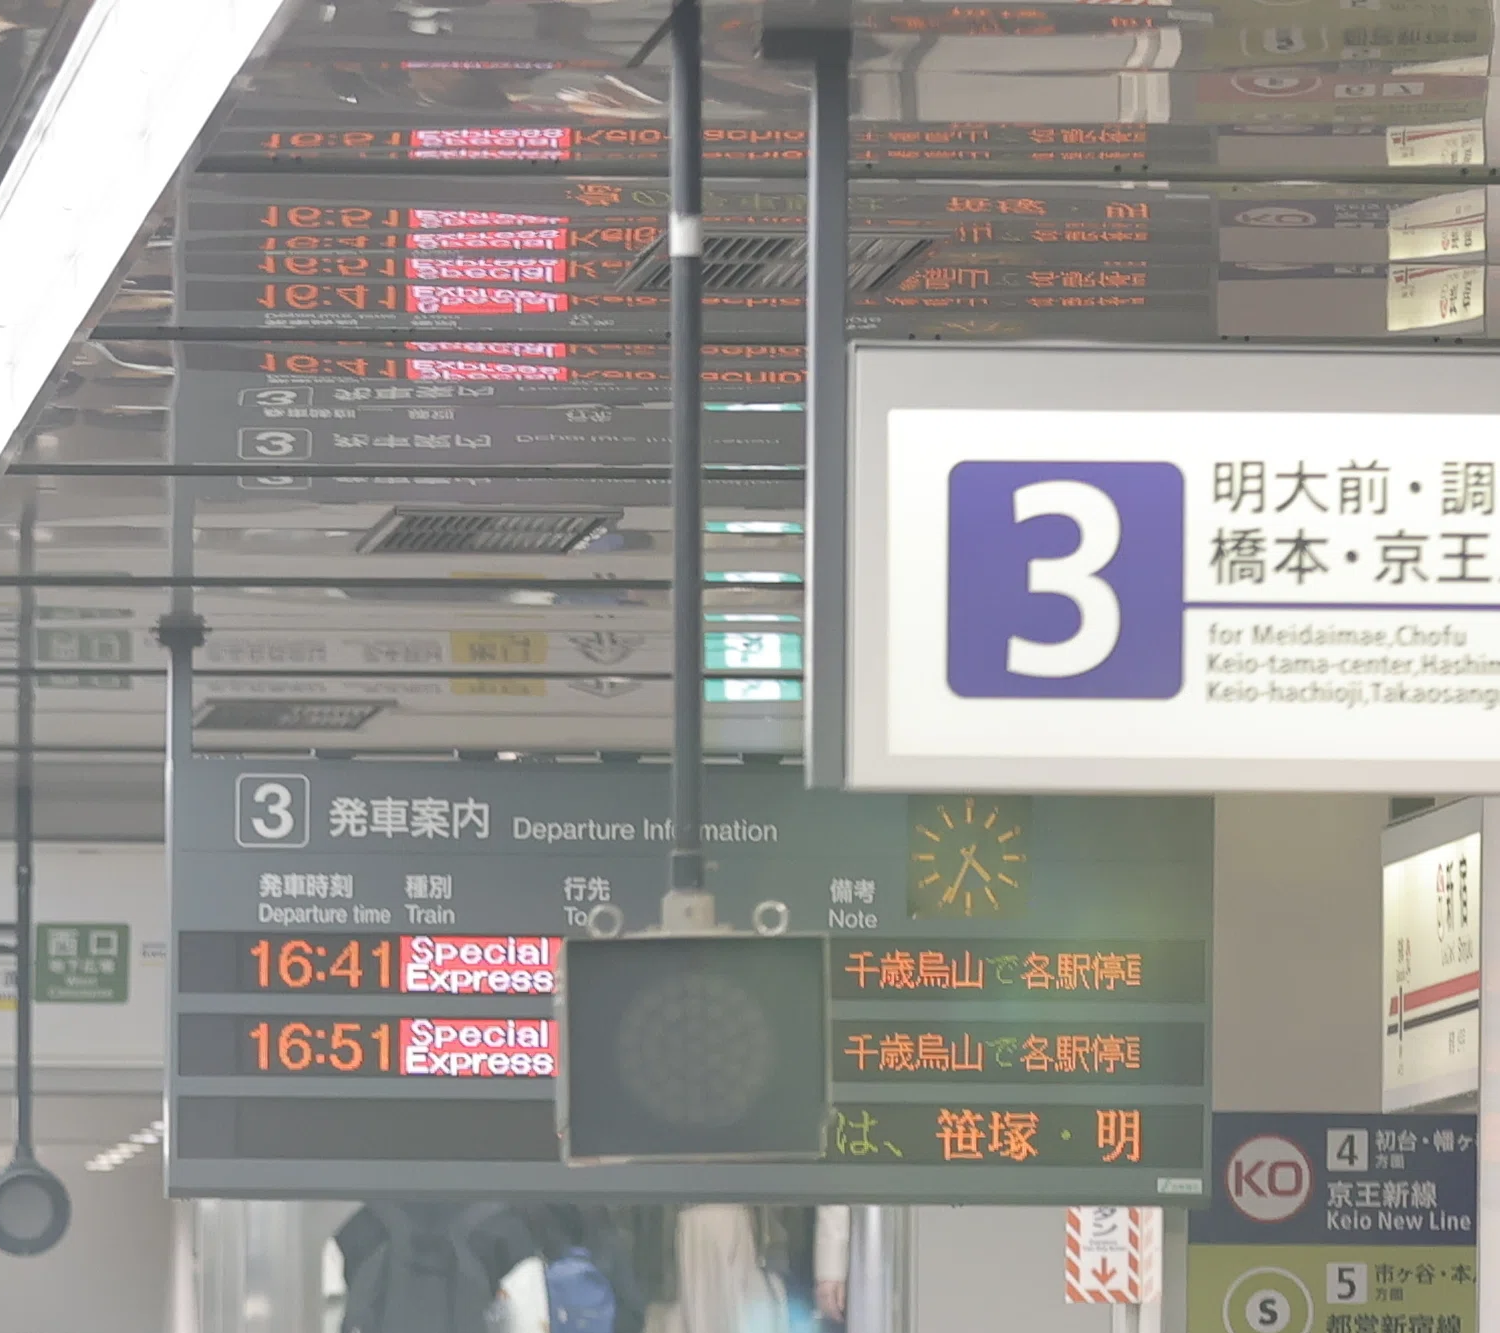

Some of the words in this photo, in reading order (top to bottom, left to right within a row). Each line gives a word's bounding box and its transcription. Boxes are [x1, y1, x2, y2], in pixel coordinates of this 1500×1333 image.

[1006, 479, 1122, 679] 3
[1208, 622, 1244, 647] for
[251, 782, 295, 839] 3
[329, 796, 491, 840] 発車案内
[513, 816, 636, 844] Departure
[643, 817, 779, 843] Infmation
[258, 873, 354, 900] 発車時刻
[404, 874, 453, 900] 種別
[563, 875, 611, 901] 行先
[829, 878, 876, 904] 備考
[258, 902, 348, 927] Departure
[353, 903, 392, 925] time
[405, 903, 456, 925] Train
[563, 905, 588, 926] To
[829, 907, 878, 930] Note
[250, 938, 391, 988] 16:41
[411, 935, 549, 966] Special
[406, 962, 555, 994] Express
[249, 1021, 391, 1071] 16:51
[411, 1018, 548, 1048] Special
[405, 1045, 555, 1077] Express
[1337, 1133, 1359, 1167] 4
[1375, 1128, 1477, 1153] 初台・幡ヶ
[1233, 1160, 1304, 1198] KO
[1327, 1179, 1438, 1209] 京王新線
[1327, 1209, 1372, 1231] Keio
[1378, 1211, 1423, 1231] New
[1429, 1210, 1472, 1231] Line
[1337, 1266, 1357, 1300] 5
[1375, 1262, 1476, 1285] 市ヶ谷・本
[1259, 1298, 1278, 1327] S
